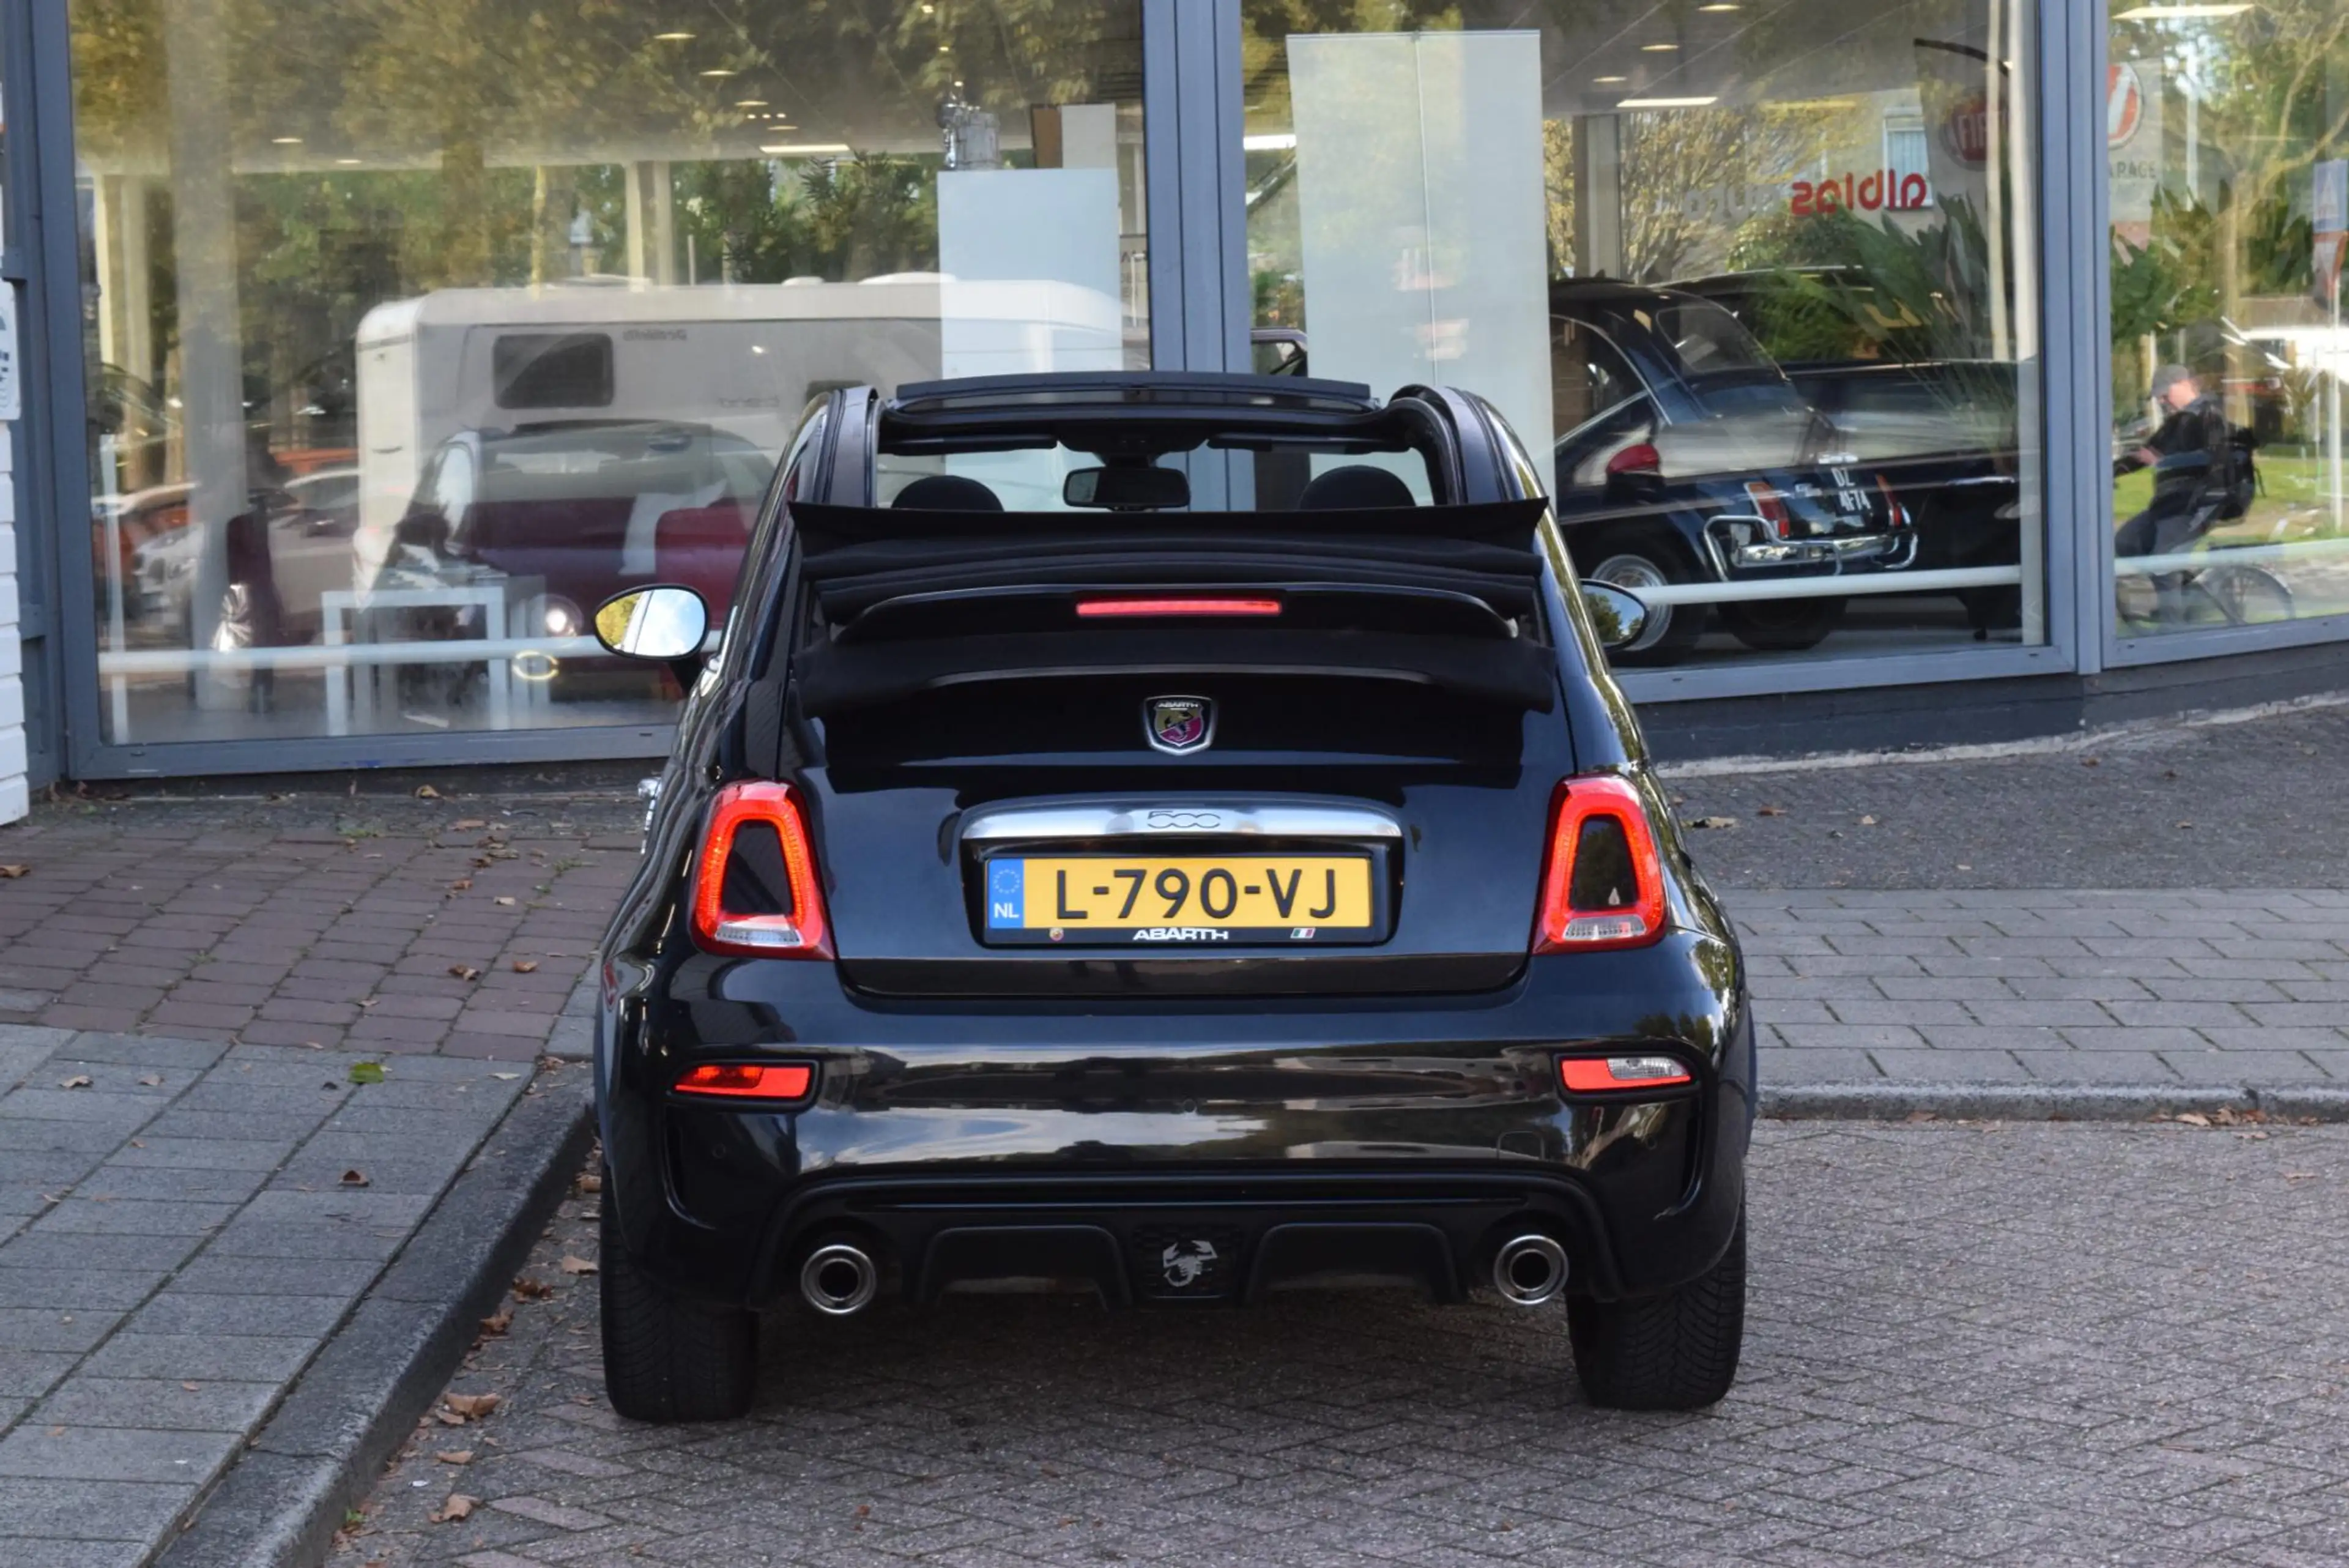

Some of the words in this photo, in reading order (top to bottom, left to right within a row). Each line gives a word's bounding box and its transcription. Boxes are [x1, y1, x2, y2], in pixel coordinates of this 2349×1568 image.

[1147, 811, 1221, 829] 500
[1056, 868, 1336, 920] L-790-VJ
[994, 903, 1020, 919] NL
[1132, 927, 1229, 941] ABARTH
